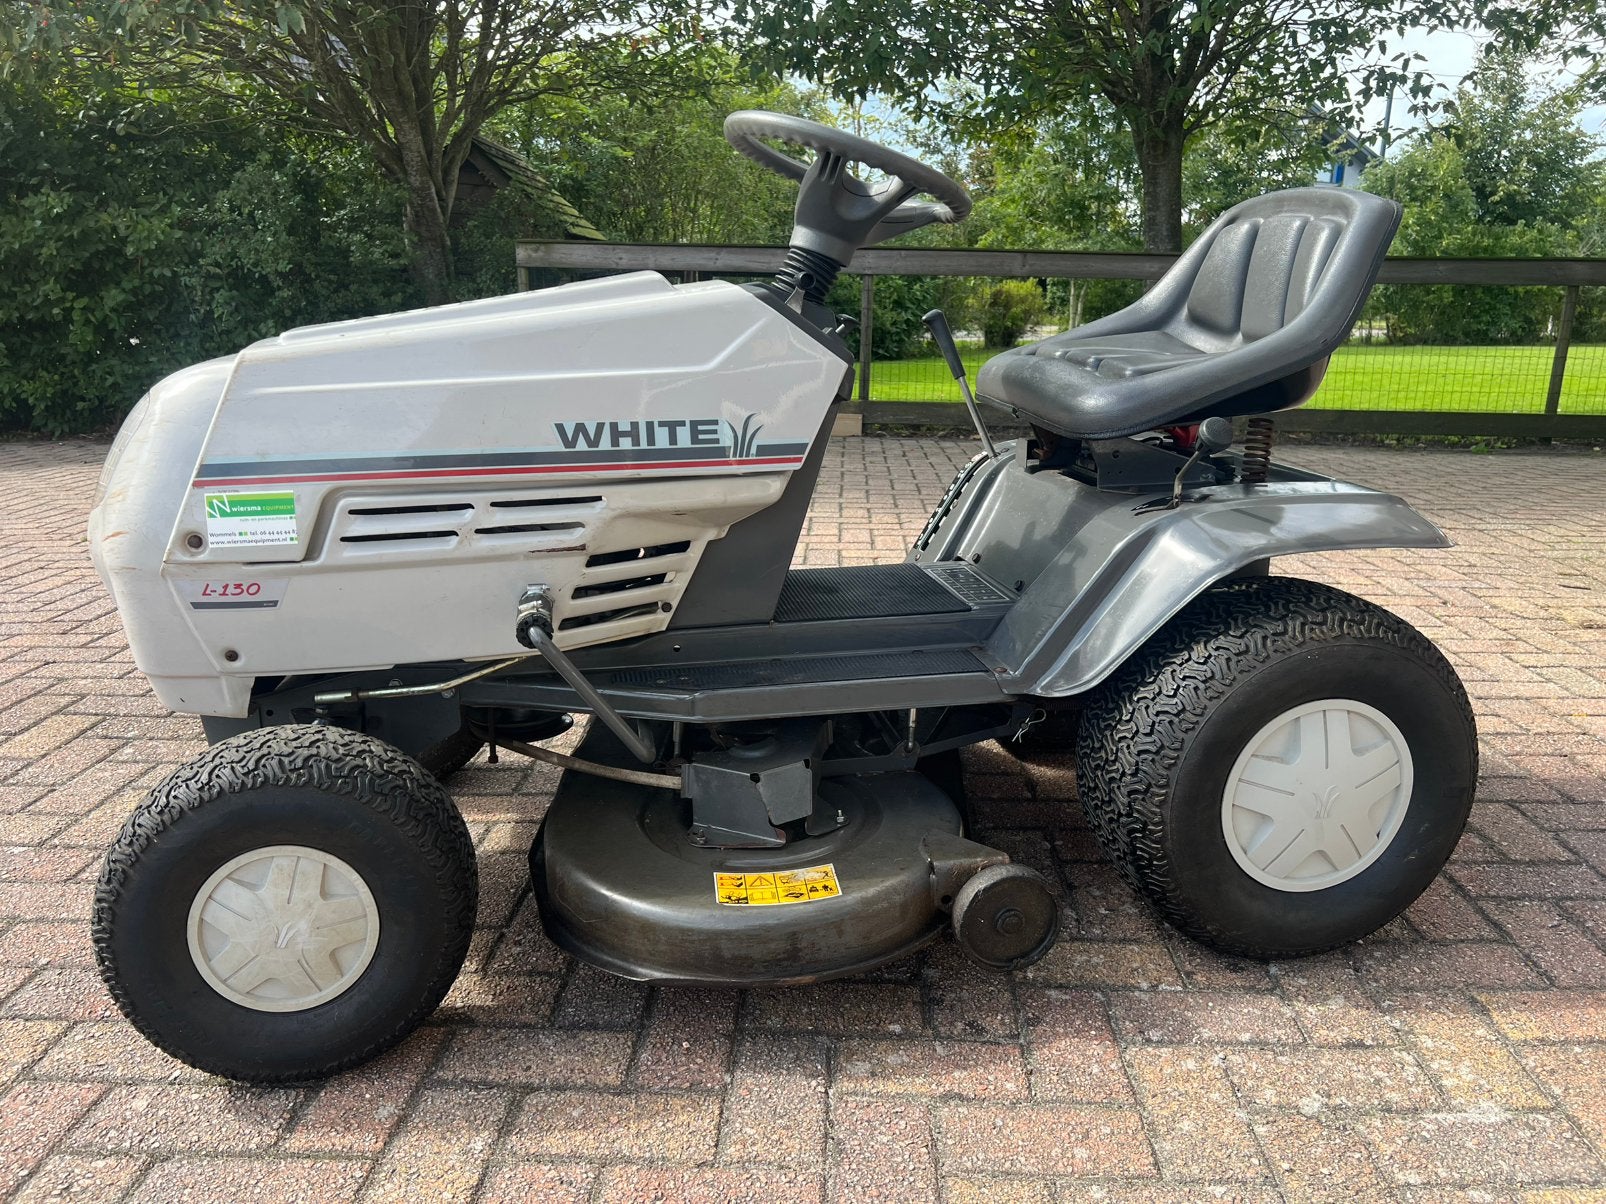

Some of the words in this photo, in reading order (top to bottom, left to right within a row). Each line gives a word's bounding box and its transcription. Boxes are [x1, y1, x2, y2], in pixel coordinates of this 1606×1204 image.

[554, 419, 720, 449] WHITE
[209, 536, 288, 545] www.wiersmaequipment.nl
[201, 582, 261, 596] L-130
